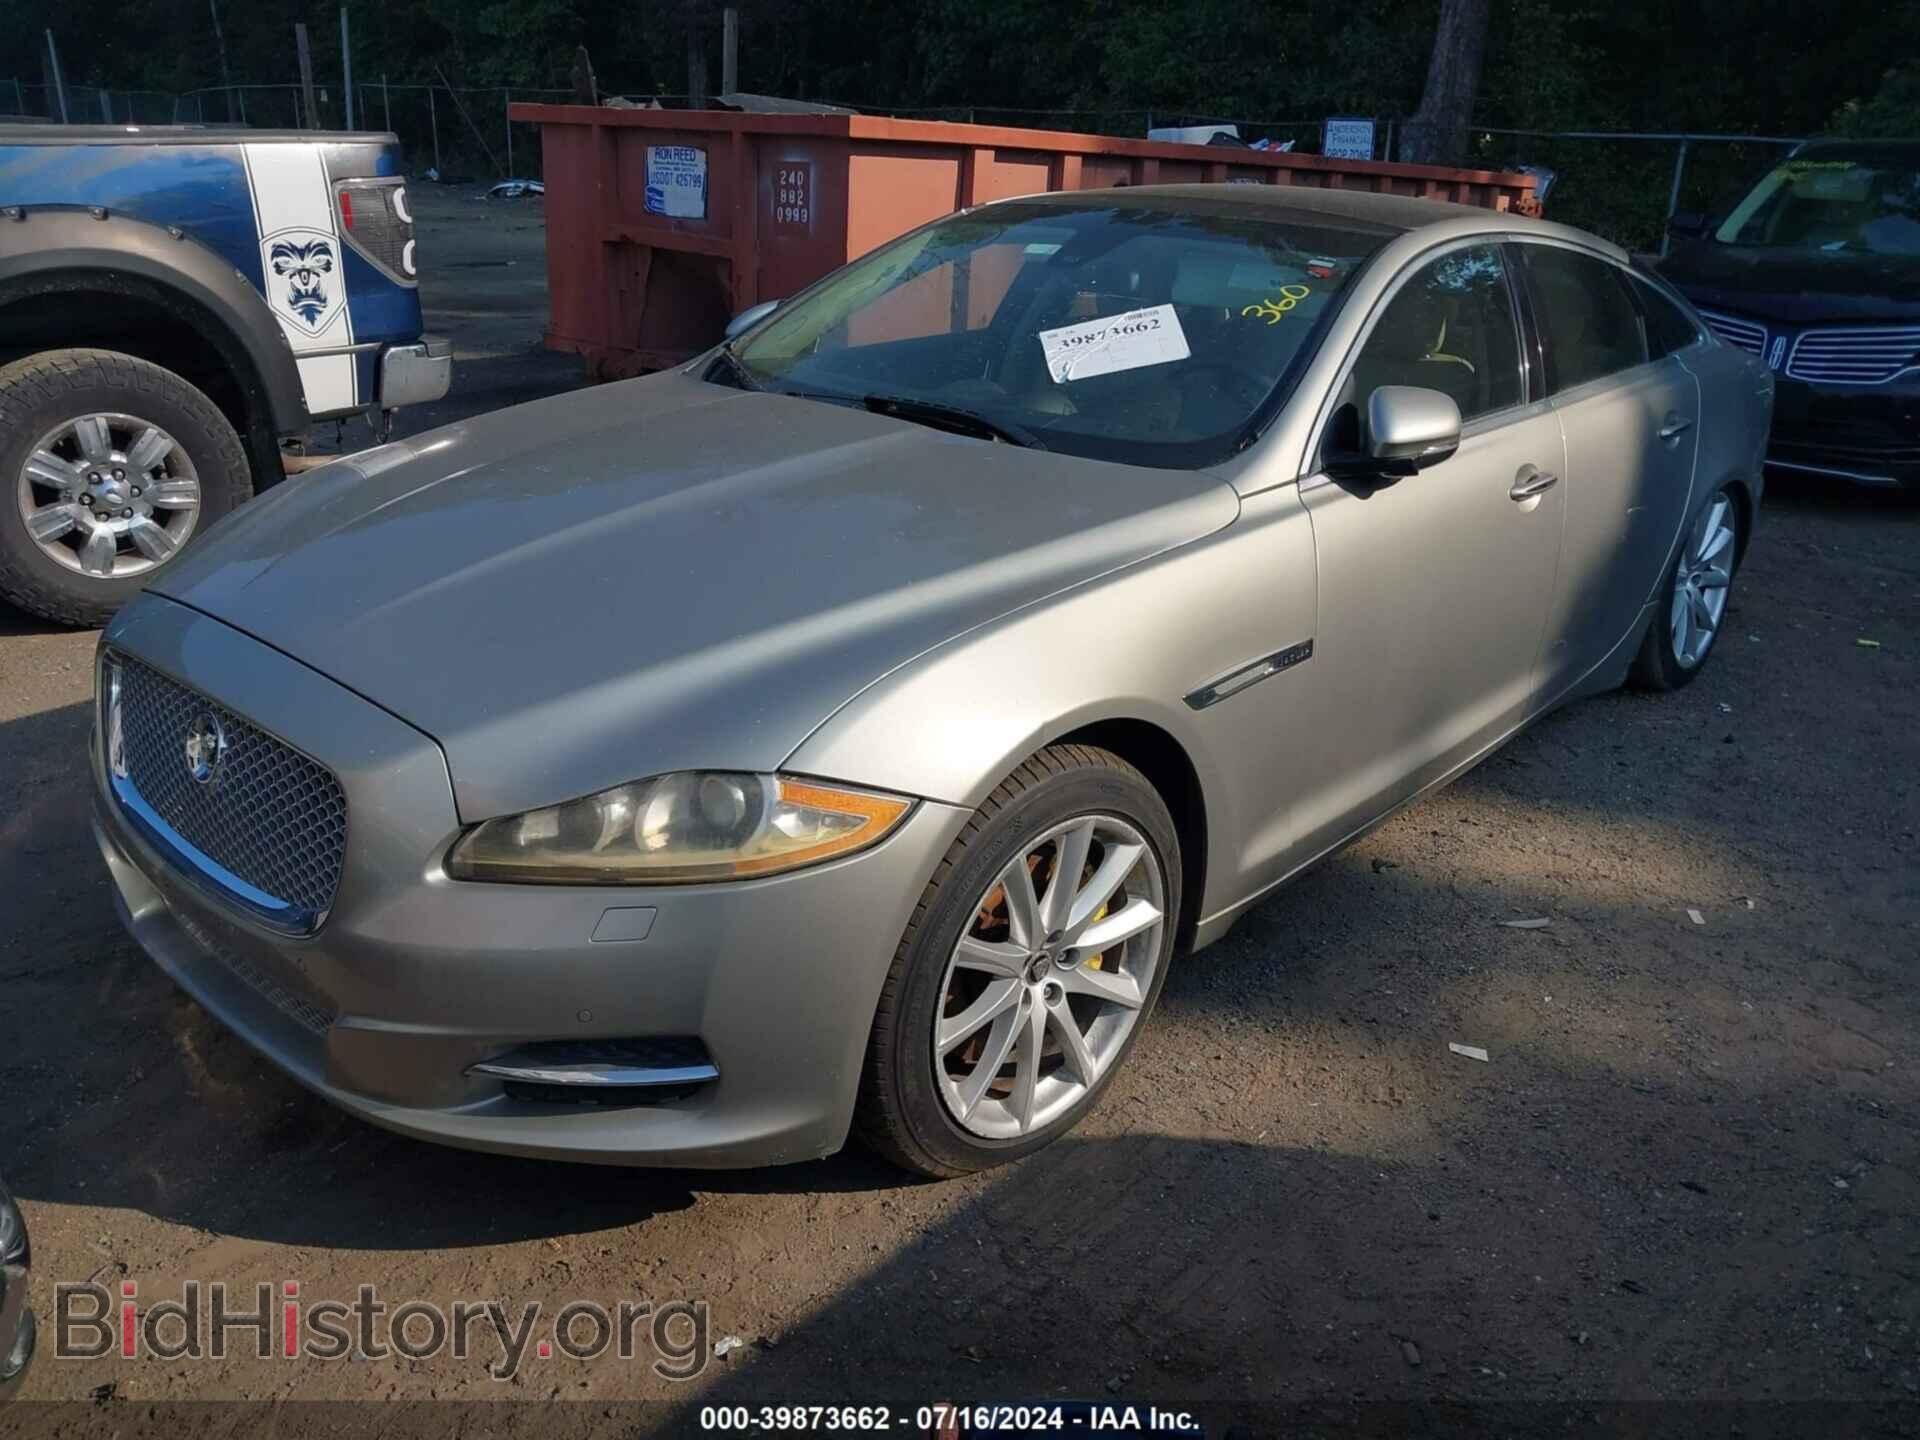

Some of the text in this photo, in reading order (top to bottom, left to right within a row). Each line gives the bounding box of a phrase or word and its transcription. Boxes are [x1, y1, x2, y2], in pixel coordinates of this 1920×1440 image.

[655, 147, 696, 162] RON REED
[651, 171, 673, 185] USDOT
[779, 169, 804, 186] 240
[1241, 284, 1310, 326] 360
[1058, 319, 1161, 351] 39873662
